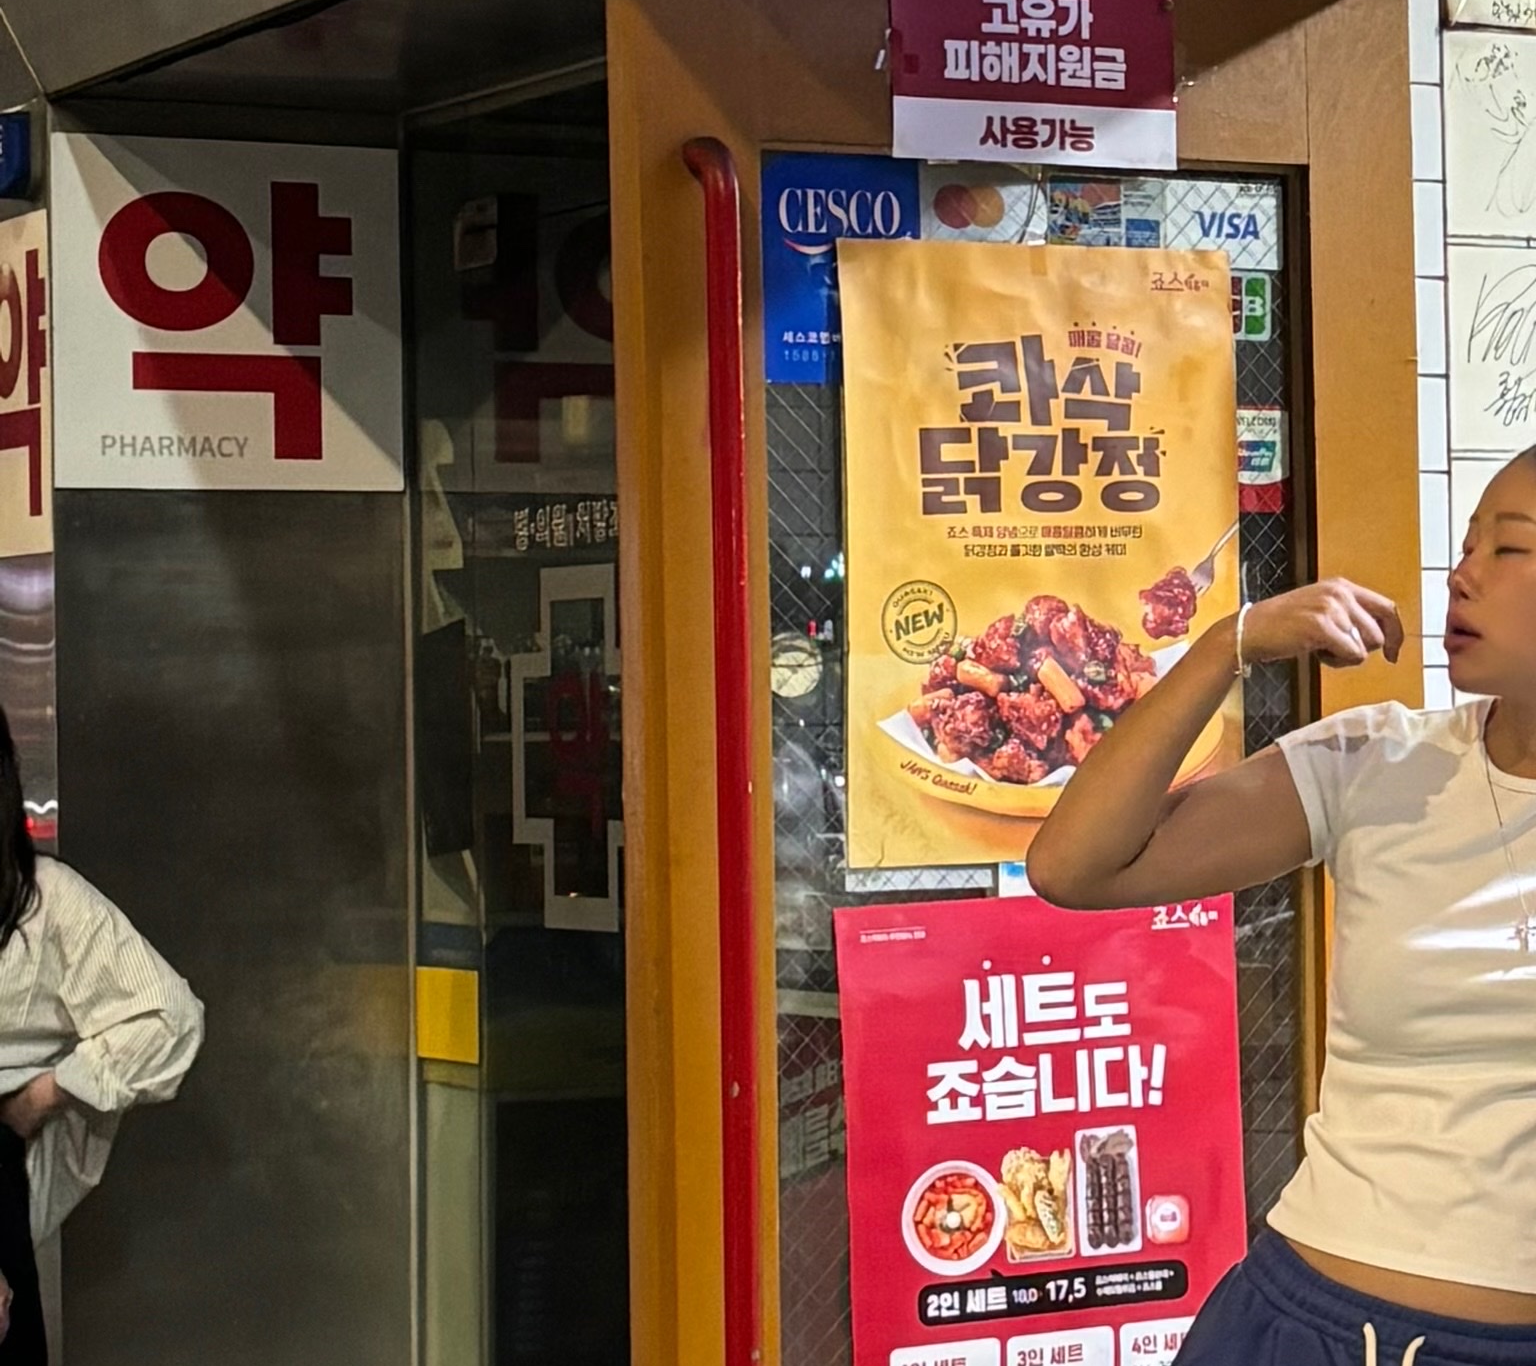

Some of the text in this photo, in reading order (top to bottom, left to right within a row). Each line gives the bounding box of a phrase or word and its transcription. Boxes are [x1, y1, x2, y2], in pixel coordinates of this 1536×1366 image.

[944, 39, 1127, 90] 피해지원금
[979, 115, 1095, 151] 사용가능
[778, 187, 901, 234] CESCO
[1193, 211, 1261, 240] VISA
[98, 181, 353, 460] 약
[954, 334, 1141, 431] 콰삭
[101, 435, 249, 459] PHARMACY
[919, 427, 1160, 516] 닭강정
[894, 602, 944, 641] NEW
[958, 971, 1131, 1051] 세트도
[927, 1044, 1166, 1125] 죠습니다!
[927, 1293, 960, 1318] 2인
[966, 1286, 1008, 1315] 세트
[1050, 1343, 1084, 1365] 세트
[1132, 1332, 1187, 1355] 4인 세
